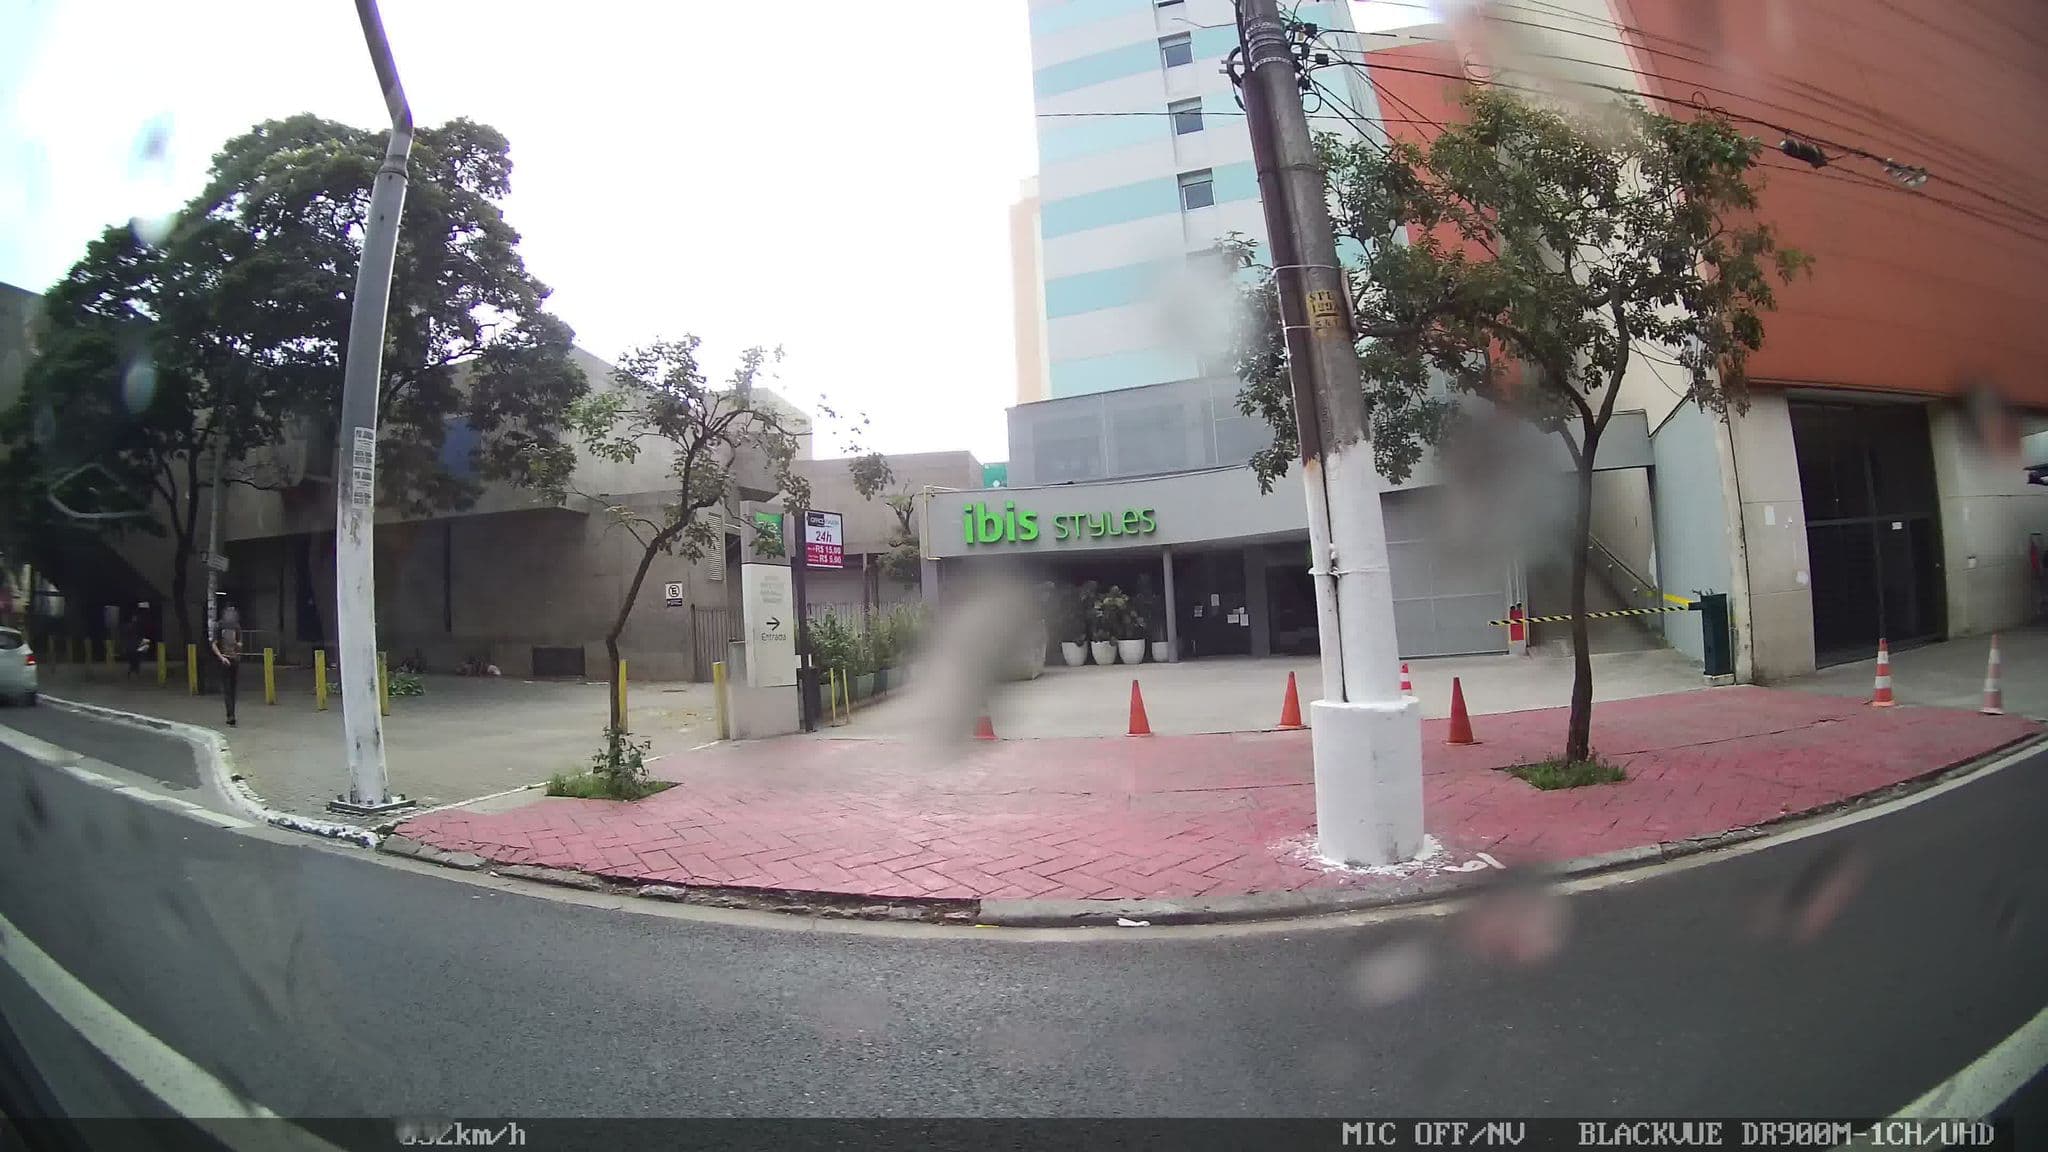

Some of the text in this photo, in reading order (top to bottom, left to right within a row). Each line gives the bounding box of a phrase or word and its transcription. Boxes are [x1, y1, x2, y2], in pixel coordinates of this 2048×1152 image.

[962, 499, 1040, 545] ibis
[815, 530, 832, 543] 24h
[761, 632, 787, 641] Entrada
